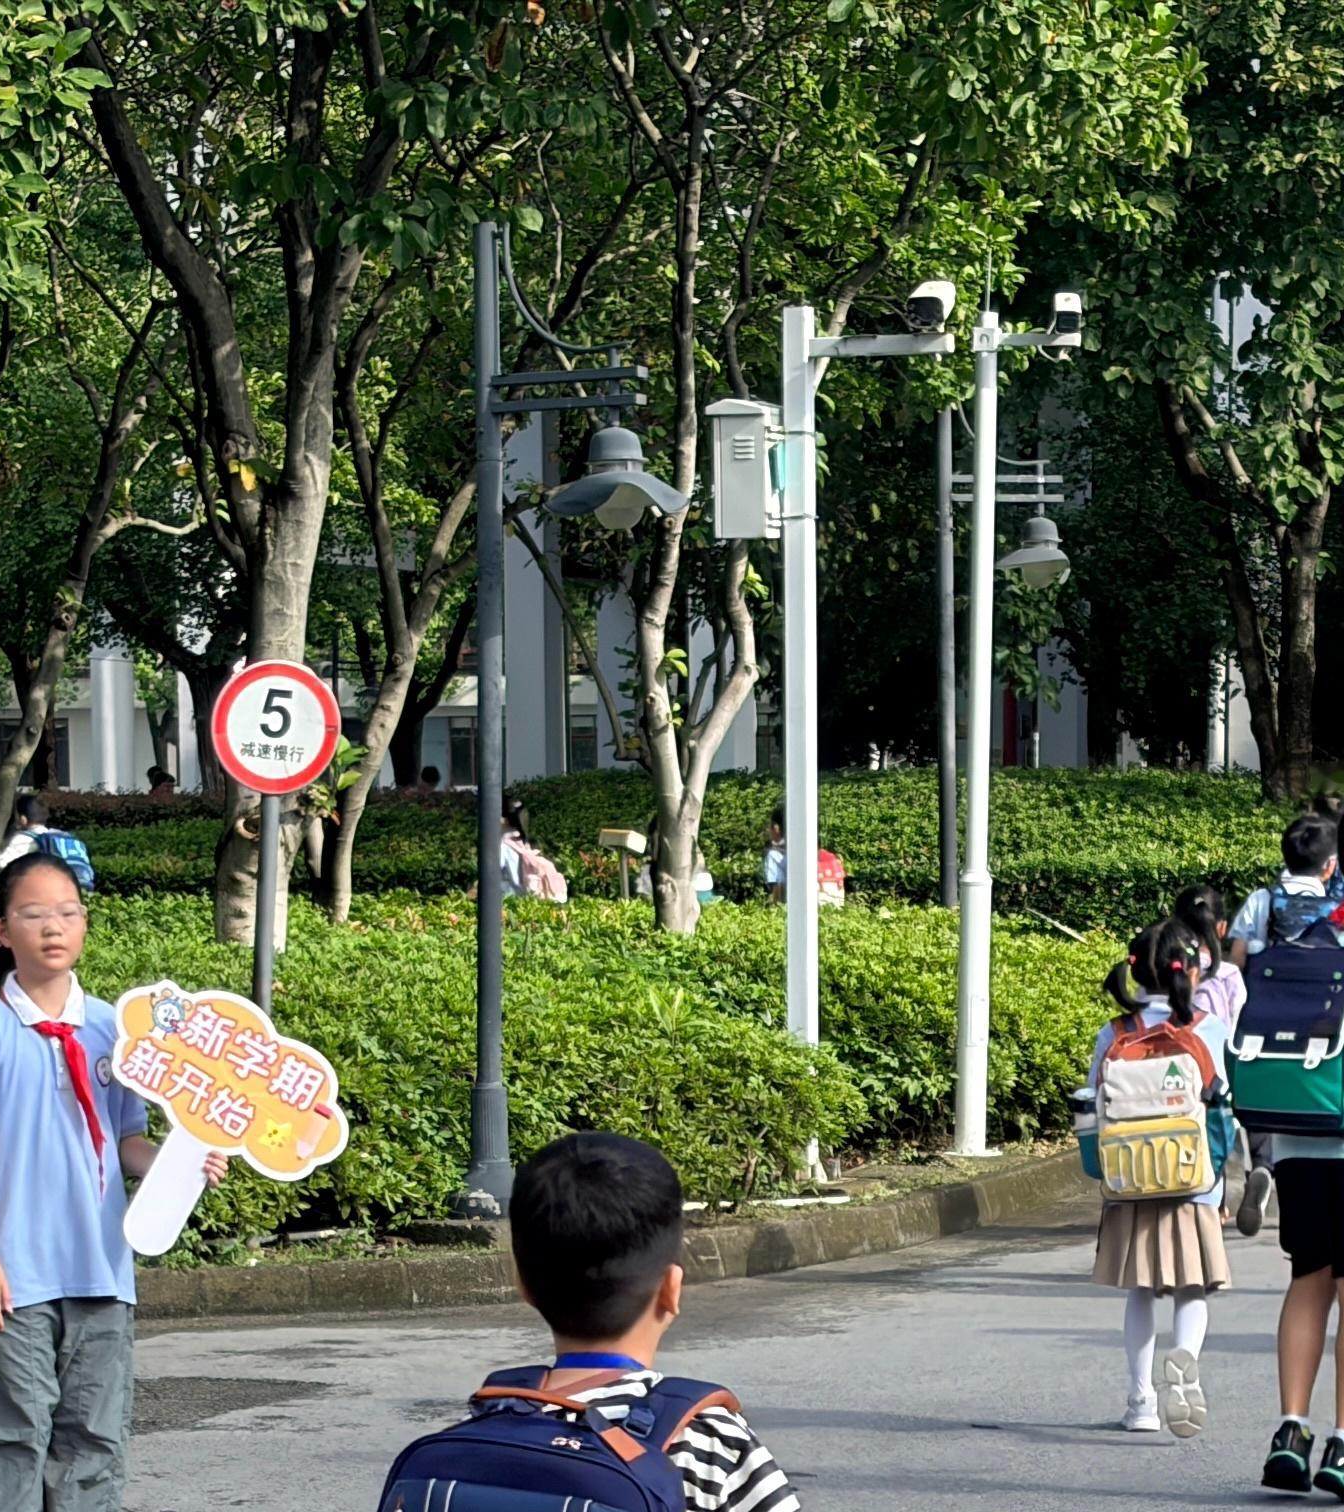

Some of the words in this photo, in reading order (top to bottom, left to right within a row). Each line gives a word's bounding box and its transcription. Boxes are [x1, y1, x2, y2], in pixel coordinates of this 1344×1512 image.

[259, 688, 293, 738] 5
[240, 742, 305, 763] 减速慢行
[120, 1038, 256, 1138] 新开始
[179, 1003, 326, 1111] 新学期
